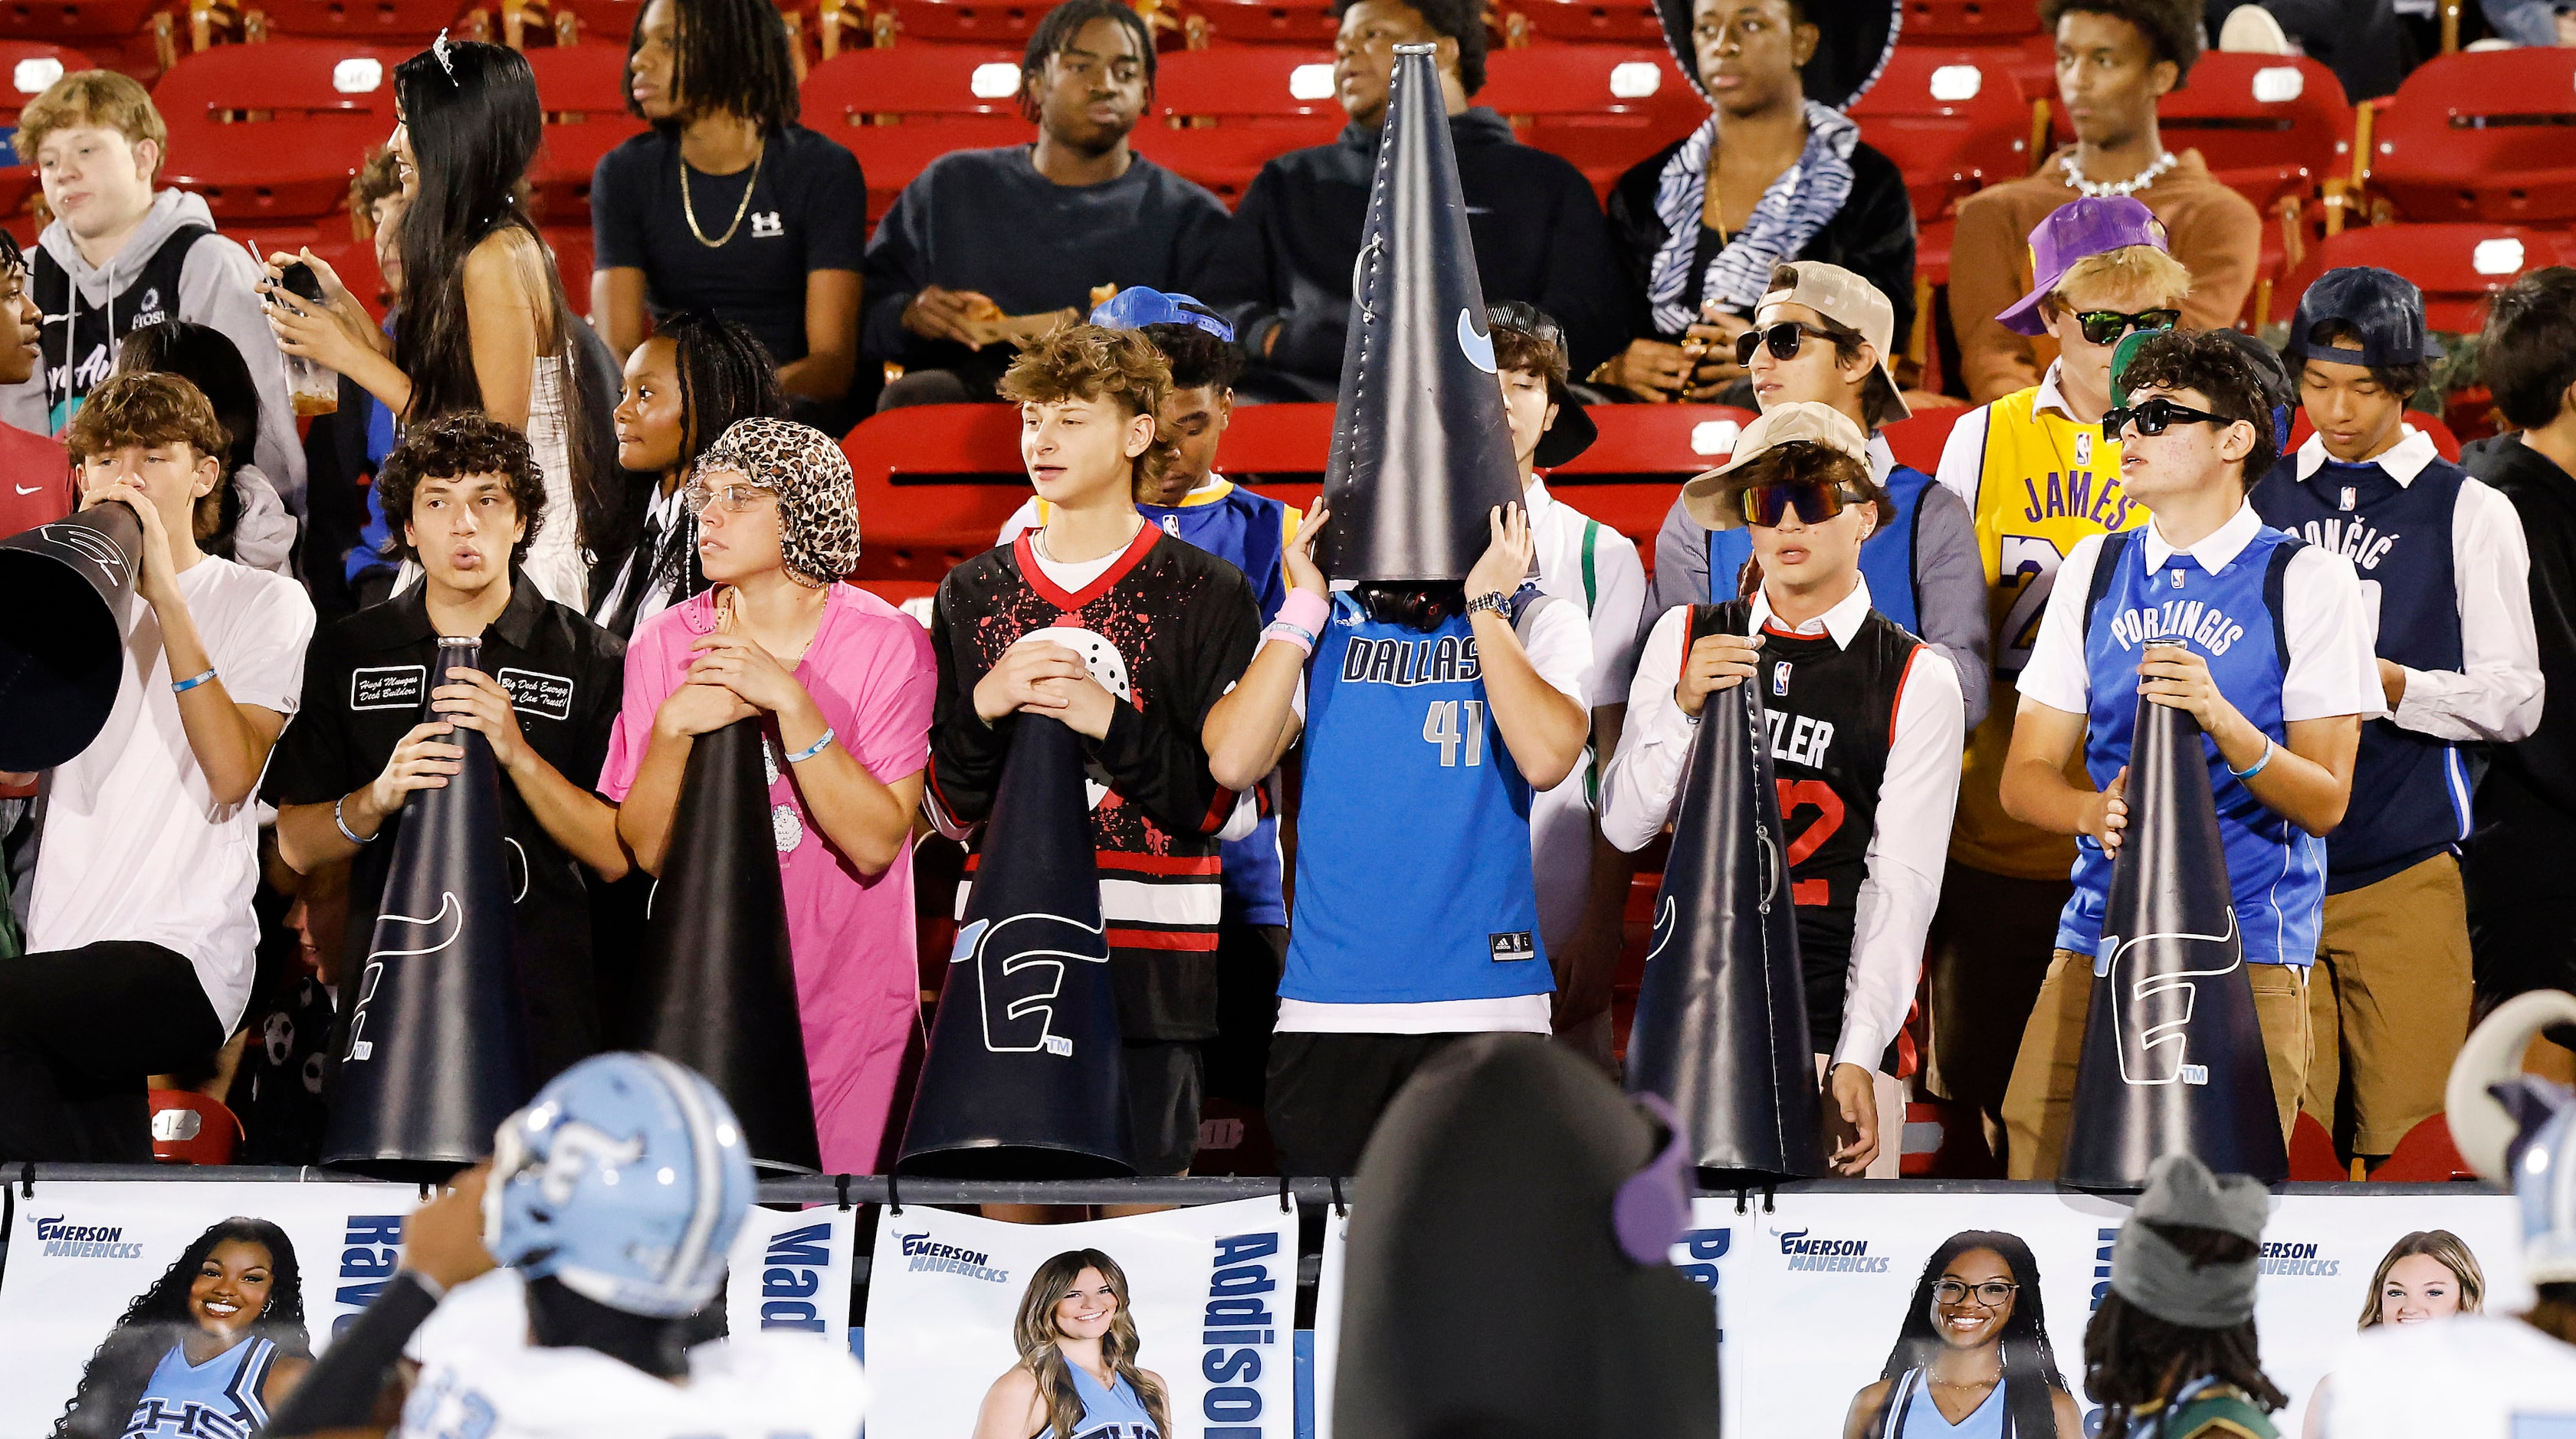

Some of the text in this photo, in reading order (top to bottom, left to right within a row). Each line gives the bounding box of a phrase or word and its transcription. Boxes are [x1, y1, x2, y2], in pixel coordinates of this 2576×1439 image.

[2025, 470, 2137, 531] JAMES
[1996, 535, 2064, 680] 2
[2111, 600, 2244, 657] PORZINGIS
[1341, 636, 1482, 687] DALLAS
[359, 677, 418, 690] Hugh Mungus
[359, 687, 416, 701] Deck Builders
[501, 678, 568, 697] Big Deck Energy
[519, 691, 538, 703] Can
[540, 694, 567, 707] Trust!
[1423, 700, 1483, 766] 41
[1763, 708, 1835, 769] TLER
[1776, 779, 1846, 906] 2
[1047, 1037, 1070, 1054] TM
[2183, 1067, 2205, 1081] TM
[38, 1214, 122, 1242] EMERSON
[1780, 1227, 1868, 1256] EMERSON
[43, 1241, 143, 1258] MAVERICKS
[902, 1231, 988, 1265] EMERSON
[2259, 1242, 2318, 1259] ERSON
[761, 1223, 831, 1333] Mad
[908, 1257, 1009, 1283] MAVERICKS
[1787, 1256, 1890, 1273] MAVERICKS
[2258, 1259, 2339, 1276] AVERICKS
